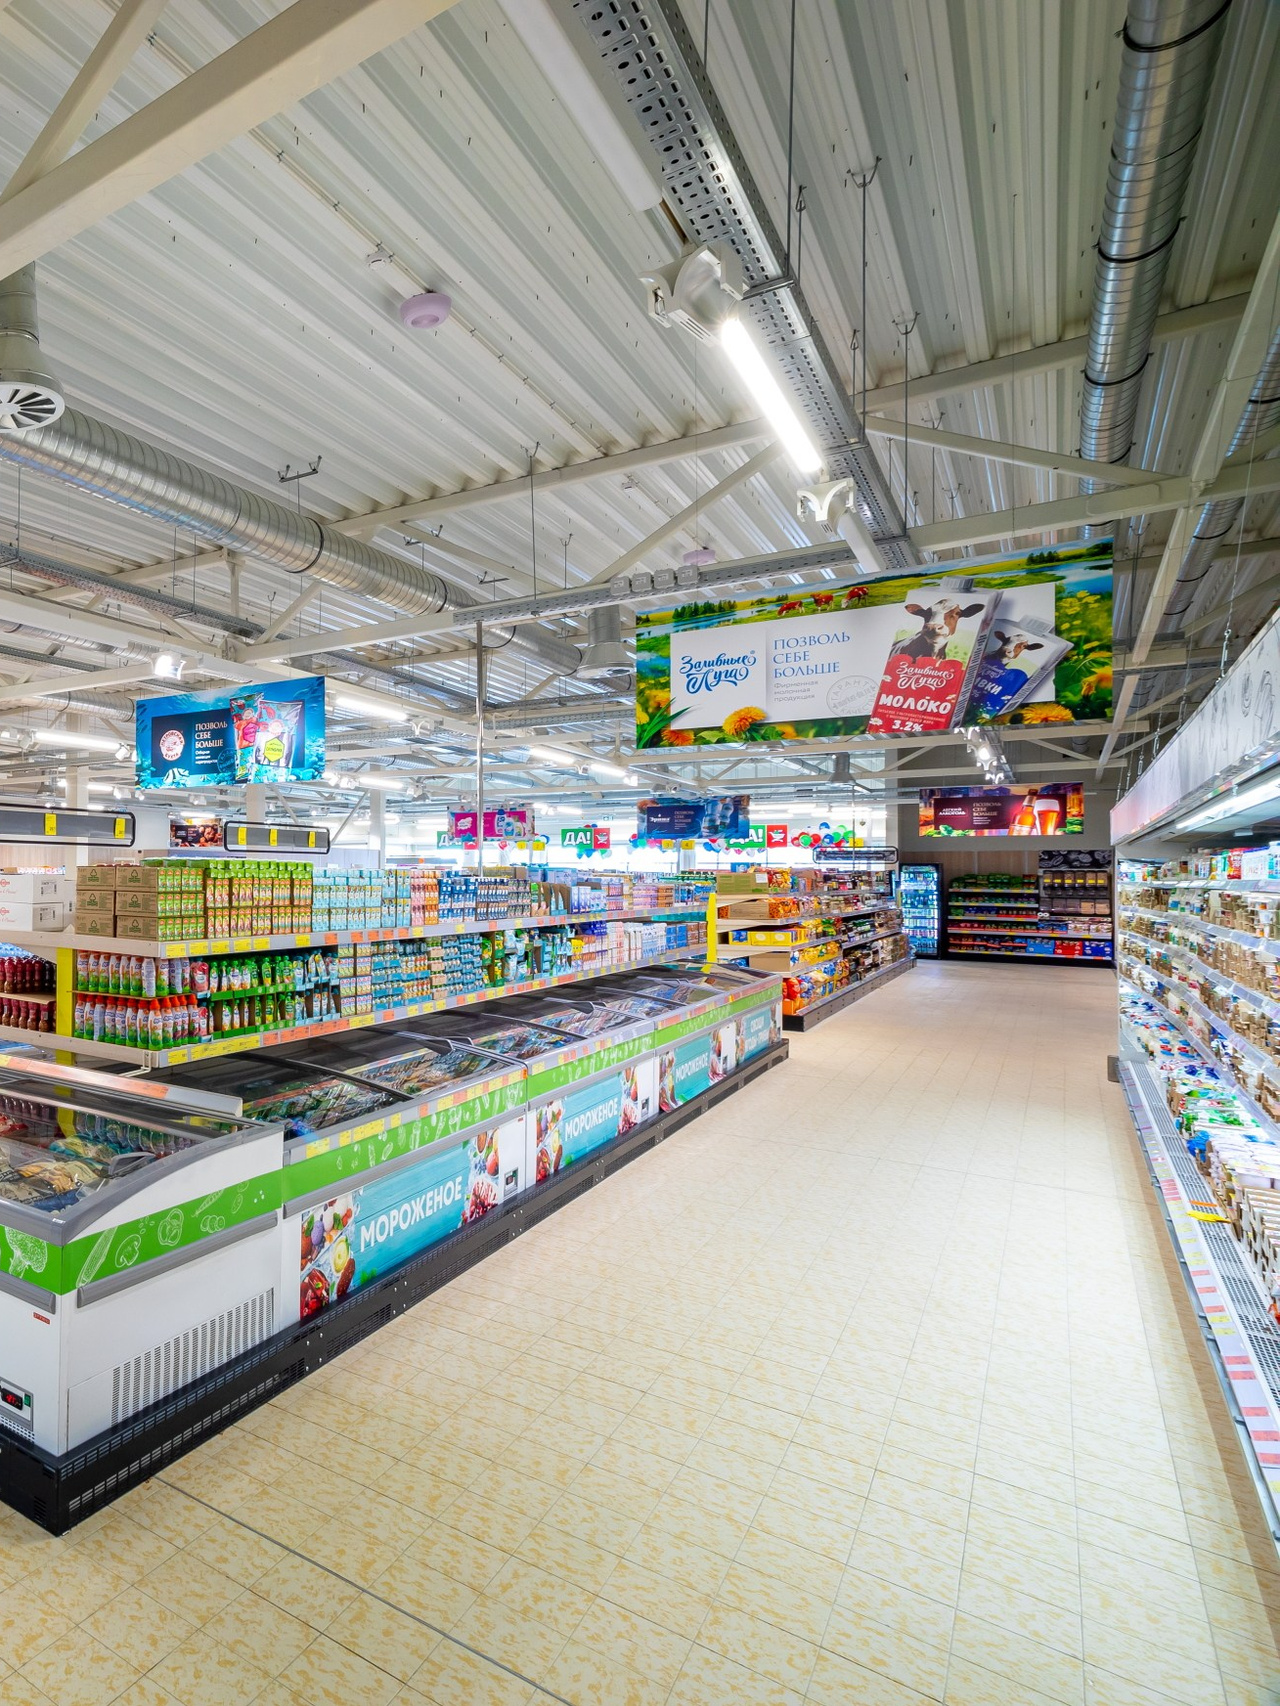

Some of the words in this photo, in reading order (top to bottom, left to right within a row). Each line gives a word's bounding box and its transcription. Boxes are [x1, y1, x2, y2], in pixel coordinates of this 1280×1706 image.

[774, 631, 851, 650] ПОЗВОЛЬ
[679, 652, 757, 674] Заливные
[773, 651, 810, 665] СЕБЕ
[774, 662, 840, 679] БОЛЬШЕ
[195, 721, 228, 731] ПОЗВОЛЬ
[891, 719, 924, 732] 3.2%
[195, 731, 211, 740] СЕБЕ
[195, 739, 224, 749] БОЛЬШЕ
[563, 832, 591, 846] ДА!
[675, 1052, 709, 1082] МОРОЖЕНОЕ
[564, 1097, 618, 1142] МОРОЖЕНОЕ
[359, 1176, 462, 1253] МОРОЖЕНОЕ
